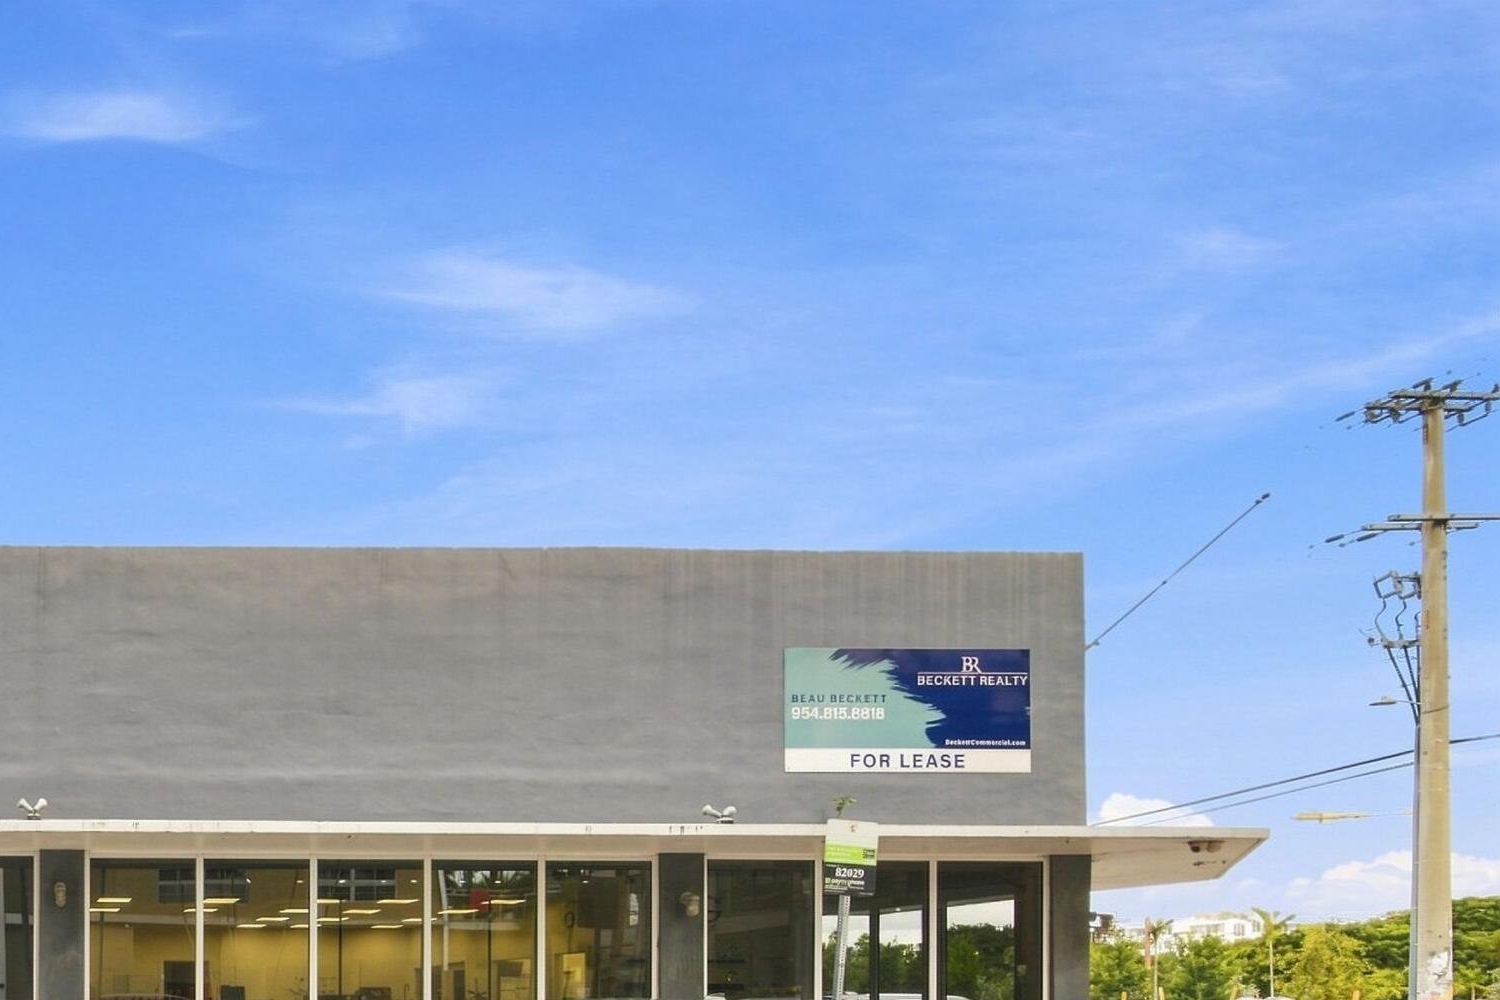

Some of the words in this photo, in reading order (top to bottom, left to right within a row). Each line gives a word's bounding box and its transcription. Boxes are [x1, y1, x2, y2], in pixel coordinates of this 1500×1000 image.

[917, 675, 976, 686] BECKETT
[980, 675, 1028, 686] REALTY
[791, 694, 825, 703] BEAU
[830, 694, 887, 703] BECKETT
[791, 706, 885, 719] 954.815.8818
[850, 753, 891, 769] FOR
[899, 753, 966, 769] LEASE
[834, 867, 865, 879] 82029
